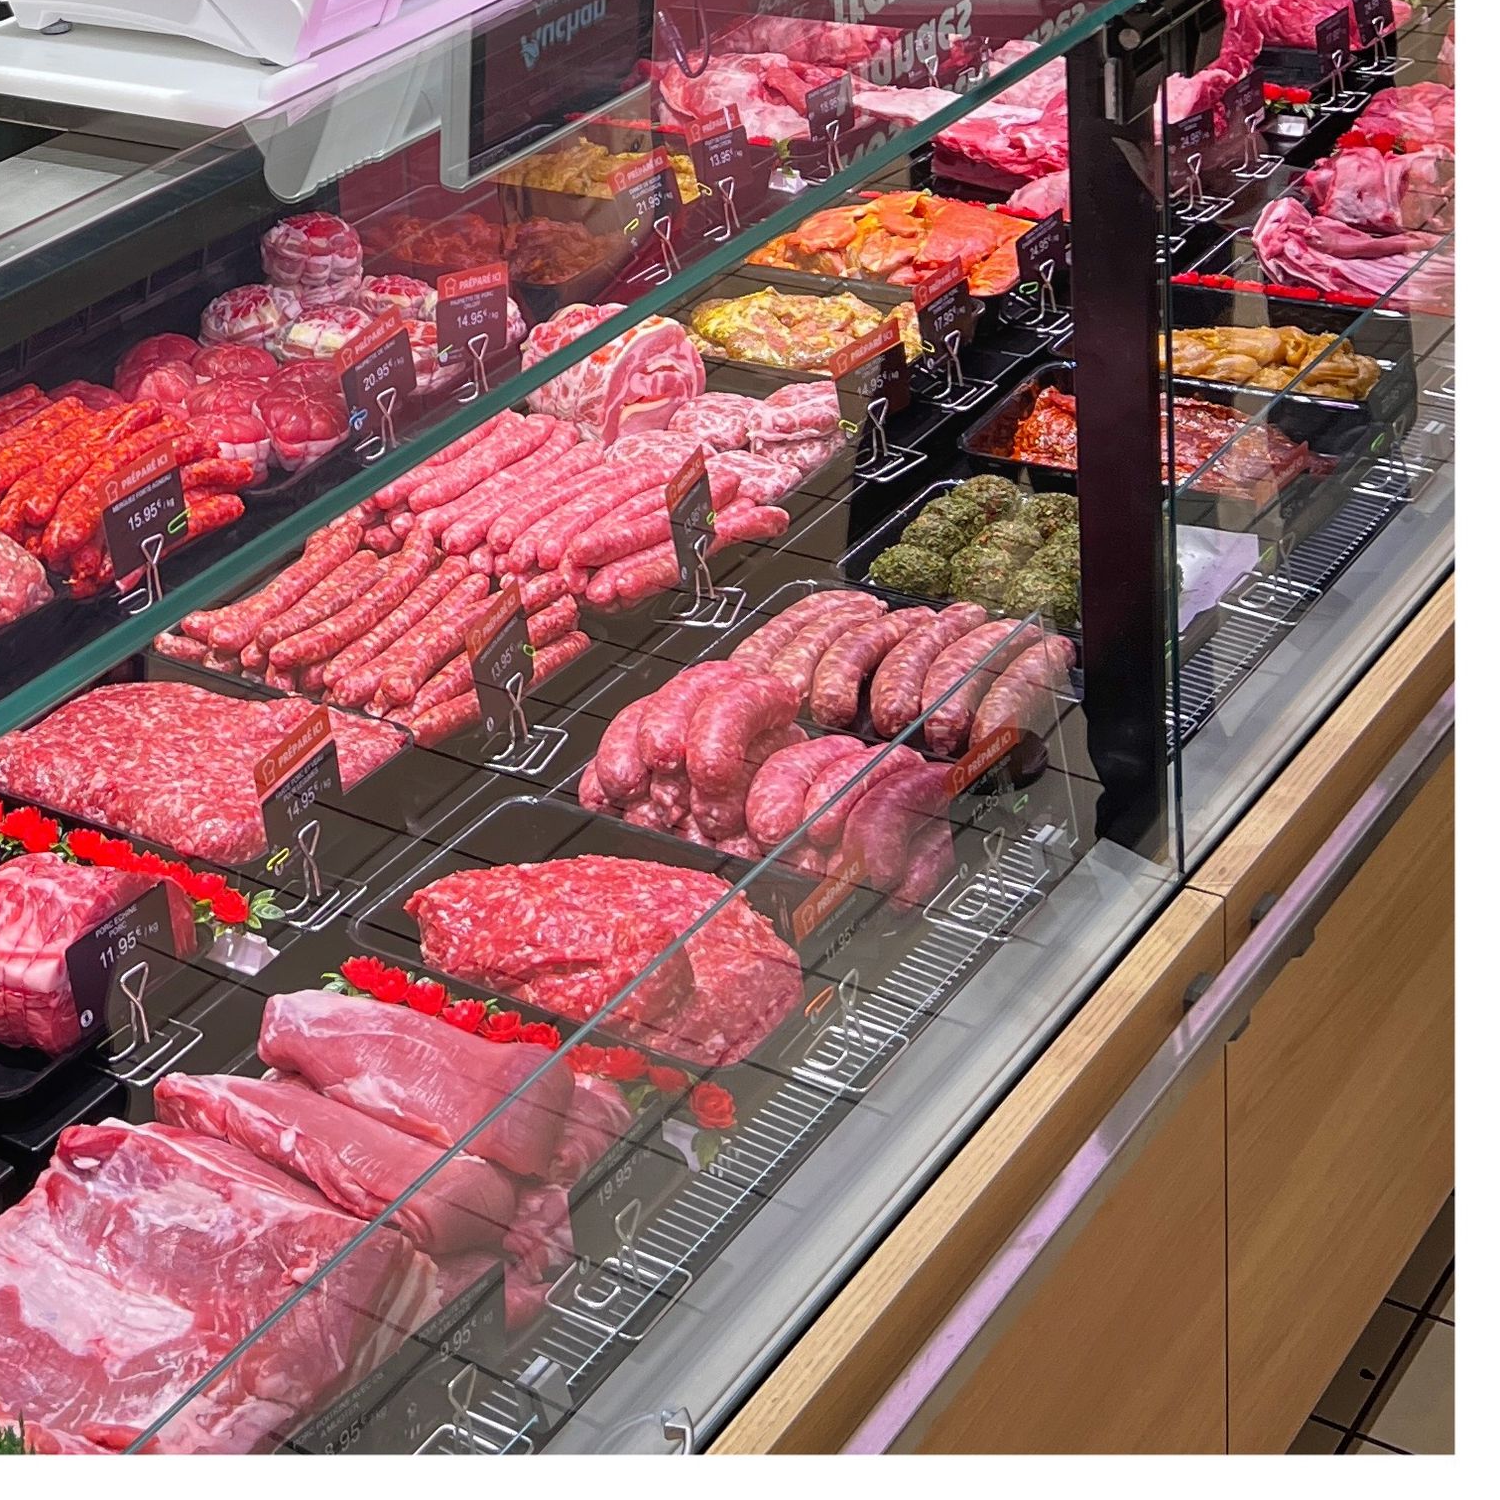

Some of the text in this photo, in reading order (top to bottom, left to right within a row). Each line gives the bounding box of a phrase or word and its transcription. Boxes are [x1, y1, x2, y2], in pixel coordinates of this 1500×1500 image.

[354, 322, 385, 355] PRÉPARÉ
[121, 453, 168, 490] PRÉPARÉ ICI
[278, 728, 313, 768] PRÉPARÉ
[95, 903, 138, 939] PORC ECHINE
[108, 921, 127, 939] PORC
